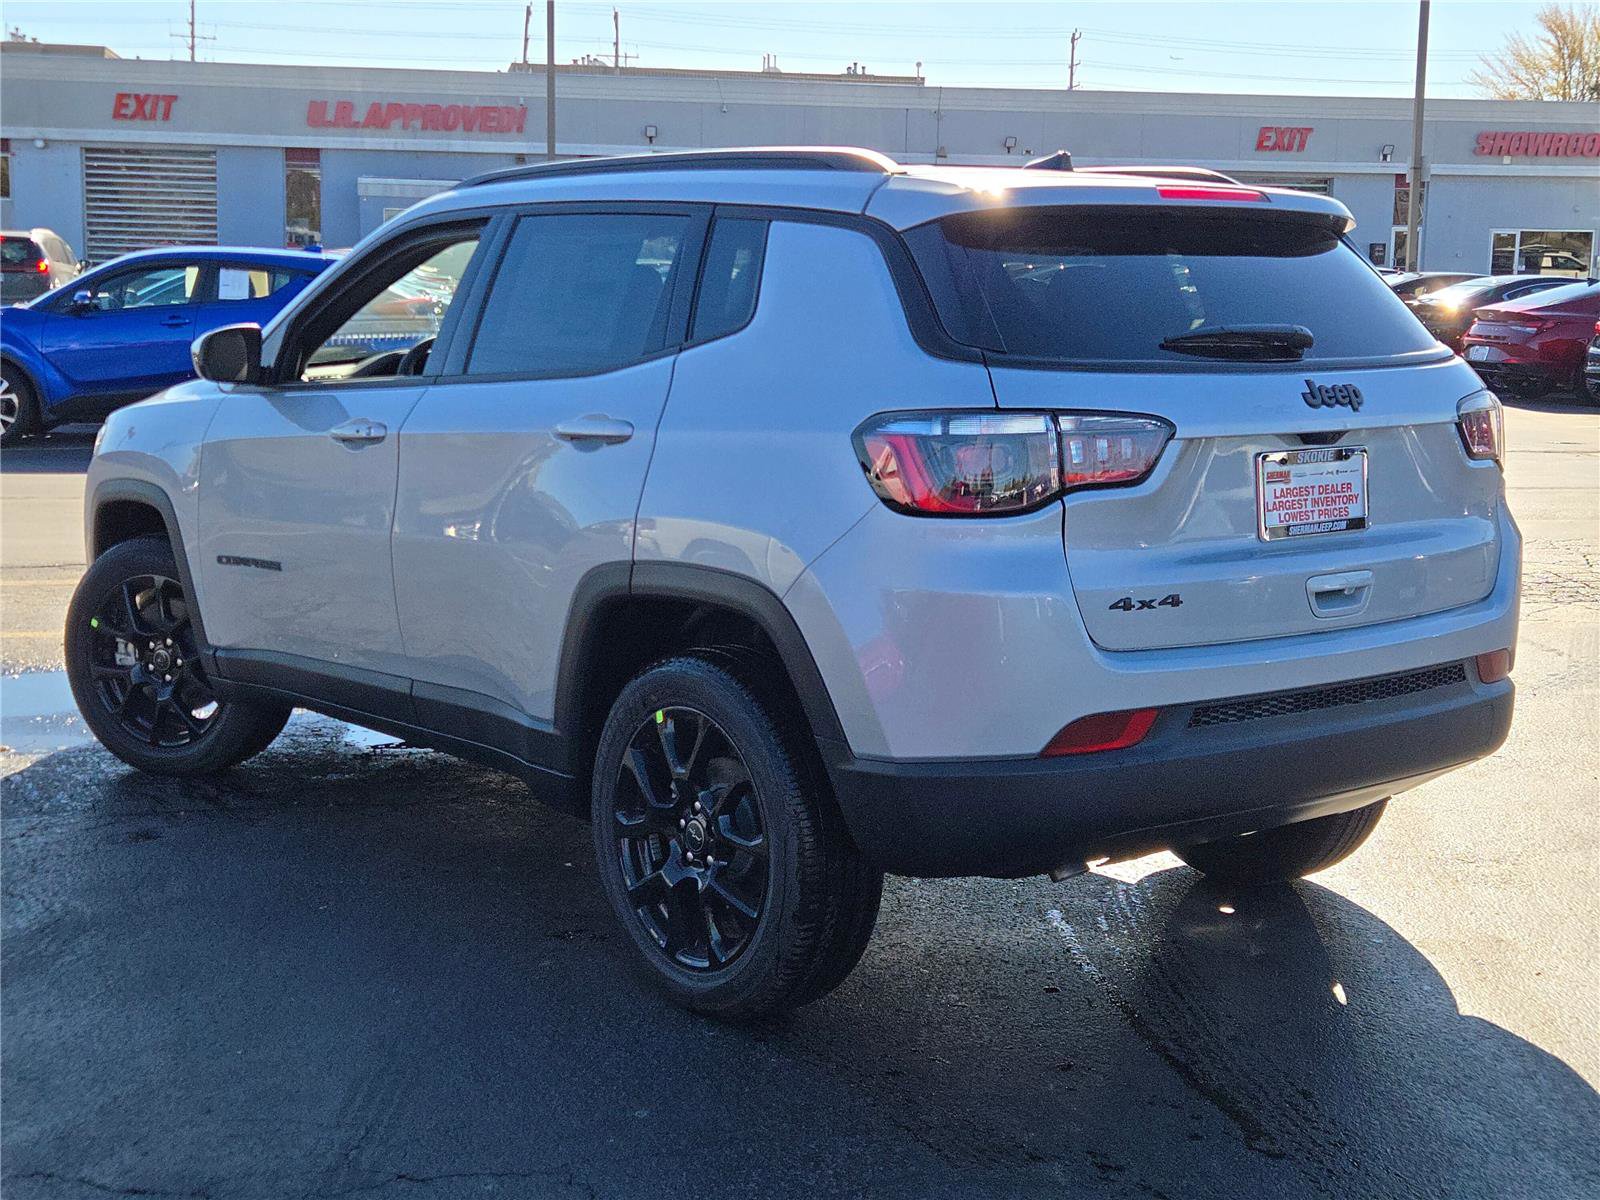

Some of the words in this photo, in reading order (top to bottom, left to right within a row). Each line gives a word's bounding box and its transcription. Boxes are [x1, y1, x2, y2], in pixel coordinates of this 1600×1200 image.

[113, 93, 178, 121] EXIT
[1255, 126, 1314, 152] EXIT
[1473, 131, 1600, 157] SHOWROO
[1301, 379, 1364, 412] Jeep
[1296, 449, 1335, 464] SKOKIE
[1273, 485, 1316, 500] LARGEST
[1318, 482, 1353, 495] DEALER
[1265, 500, 1309, 513] LARGEST
[1311, 493, 1360, 507] INVENTORY
[1278, 510, 1316, 524] LOWEST
[1318, 506, 1350, 520] PRICES
[1288, 520, 1348, 536] SHERMANJEEP.COM
[1109, 593, 1184, 612] 4x4
